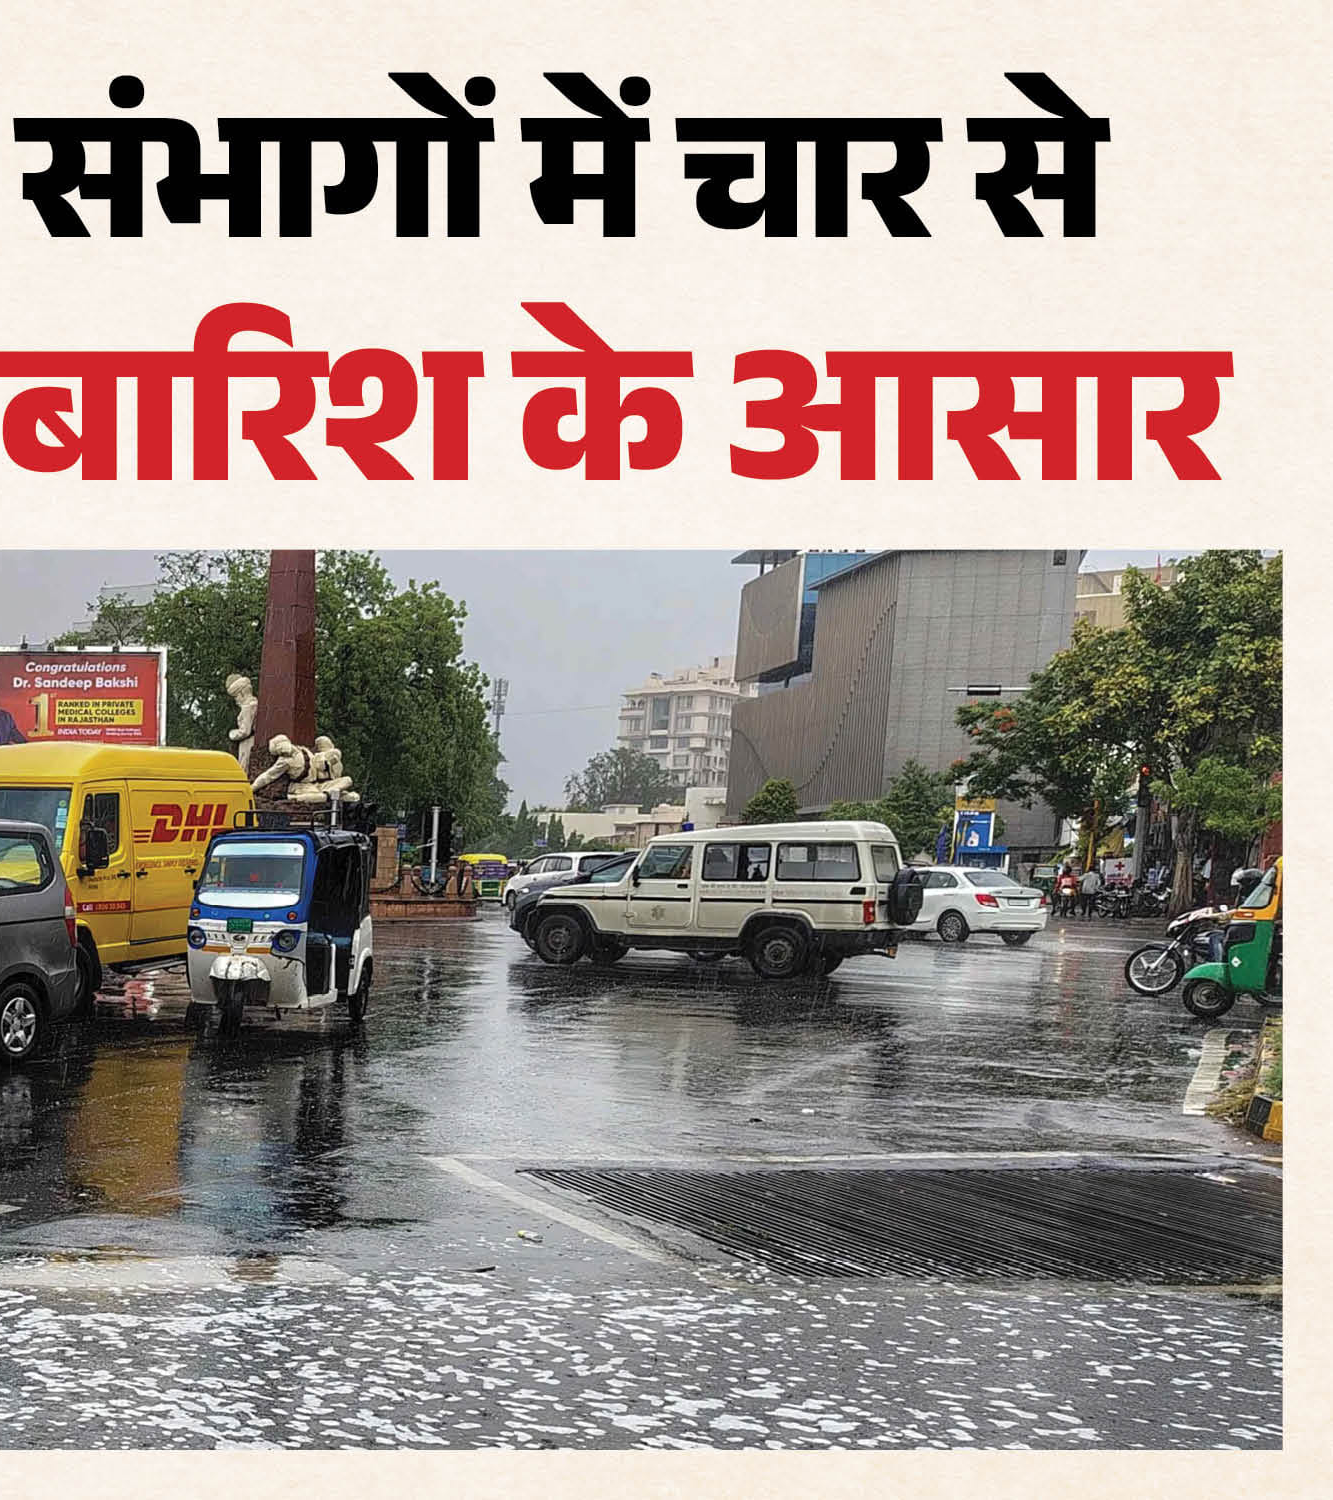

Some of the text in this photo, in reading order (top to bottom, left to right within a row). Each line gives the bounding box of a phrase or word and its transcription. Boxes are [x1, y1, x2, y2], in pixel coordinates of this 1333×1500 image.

[25, 661, 127, 675] Congratulations
[12, 677, 138, 691] Dr. Sandeep Bakshi
[57, 728, 78, 736] INDIA
[78, 728, 103, 736] TODAY
[150, 803, 228, 842] DHL
